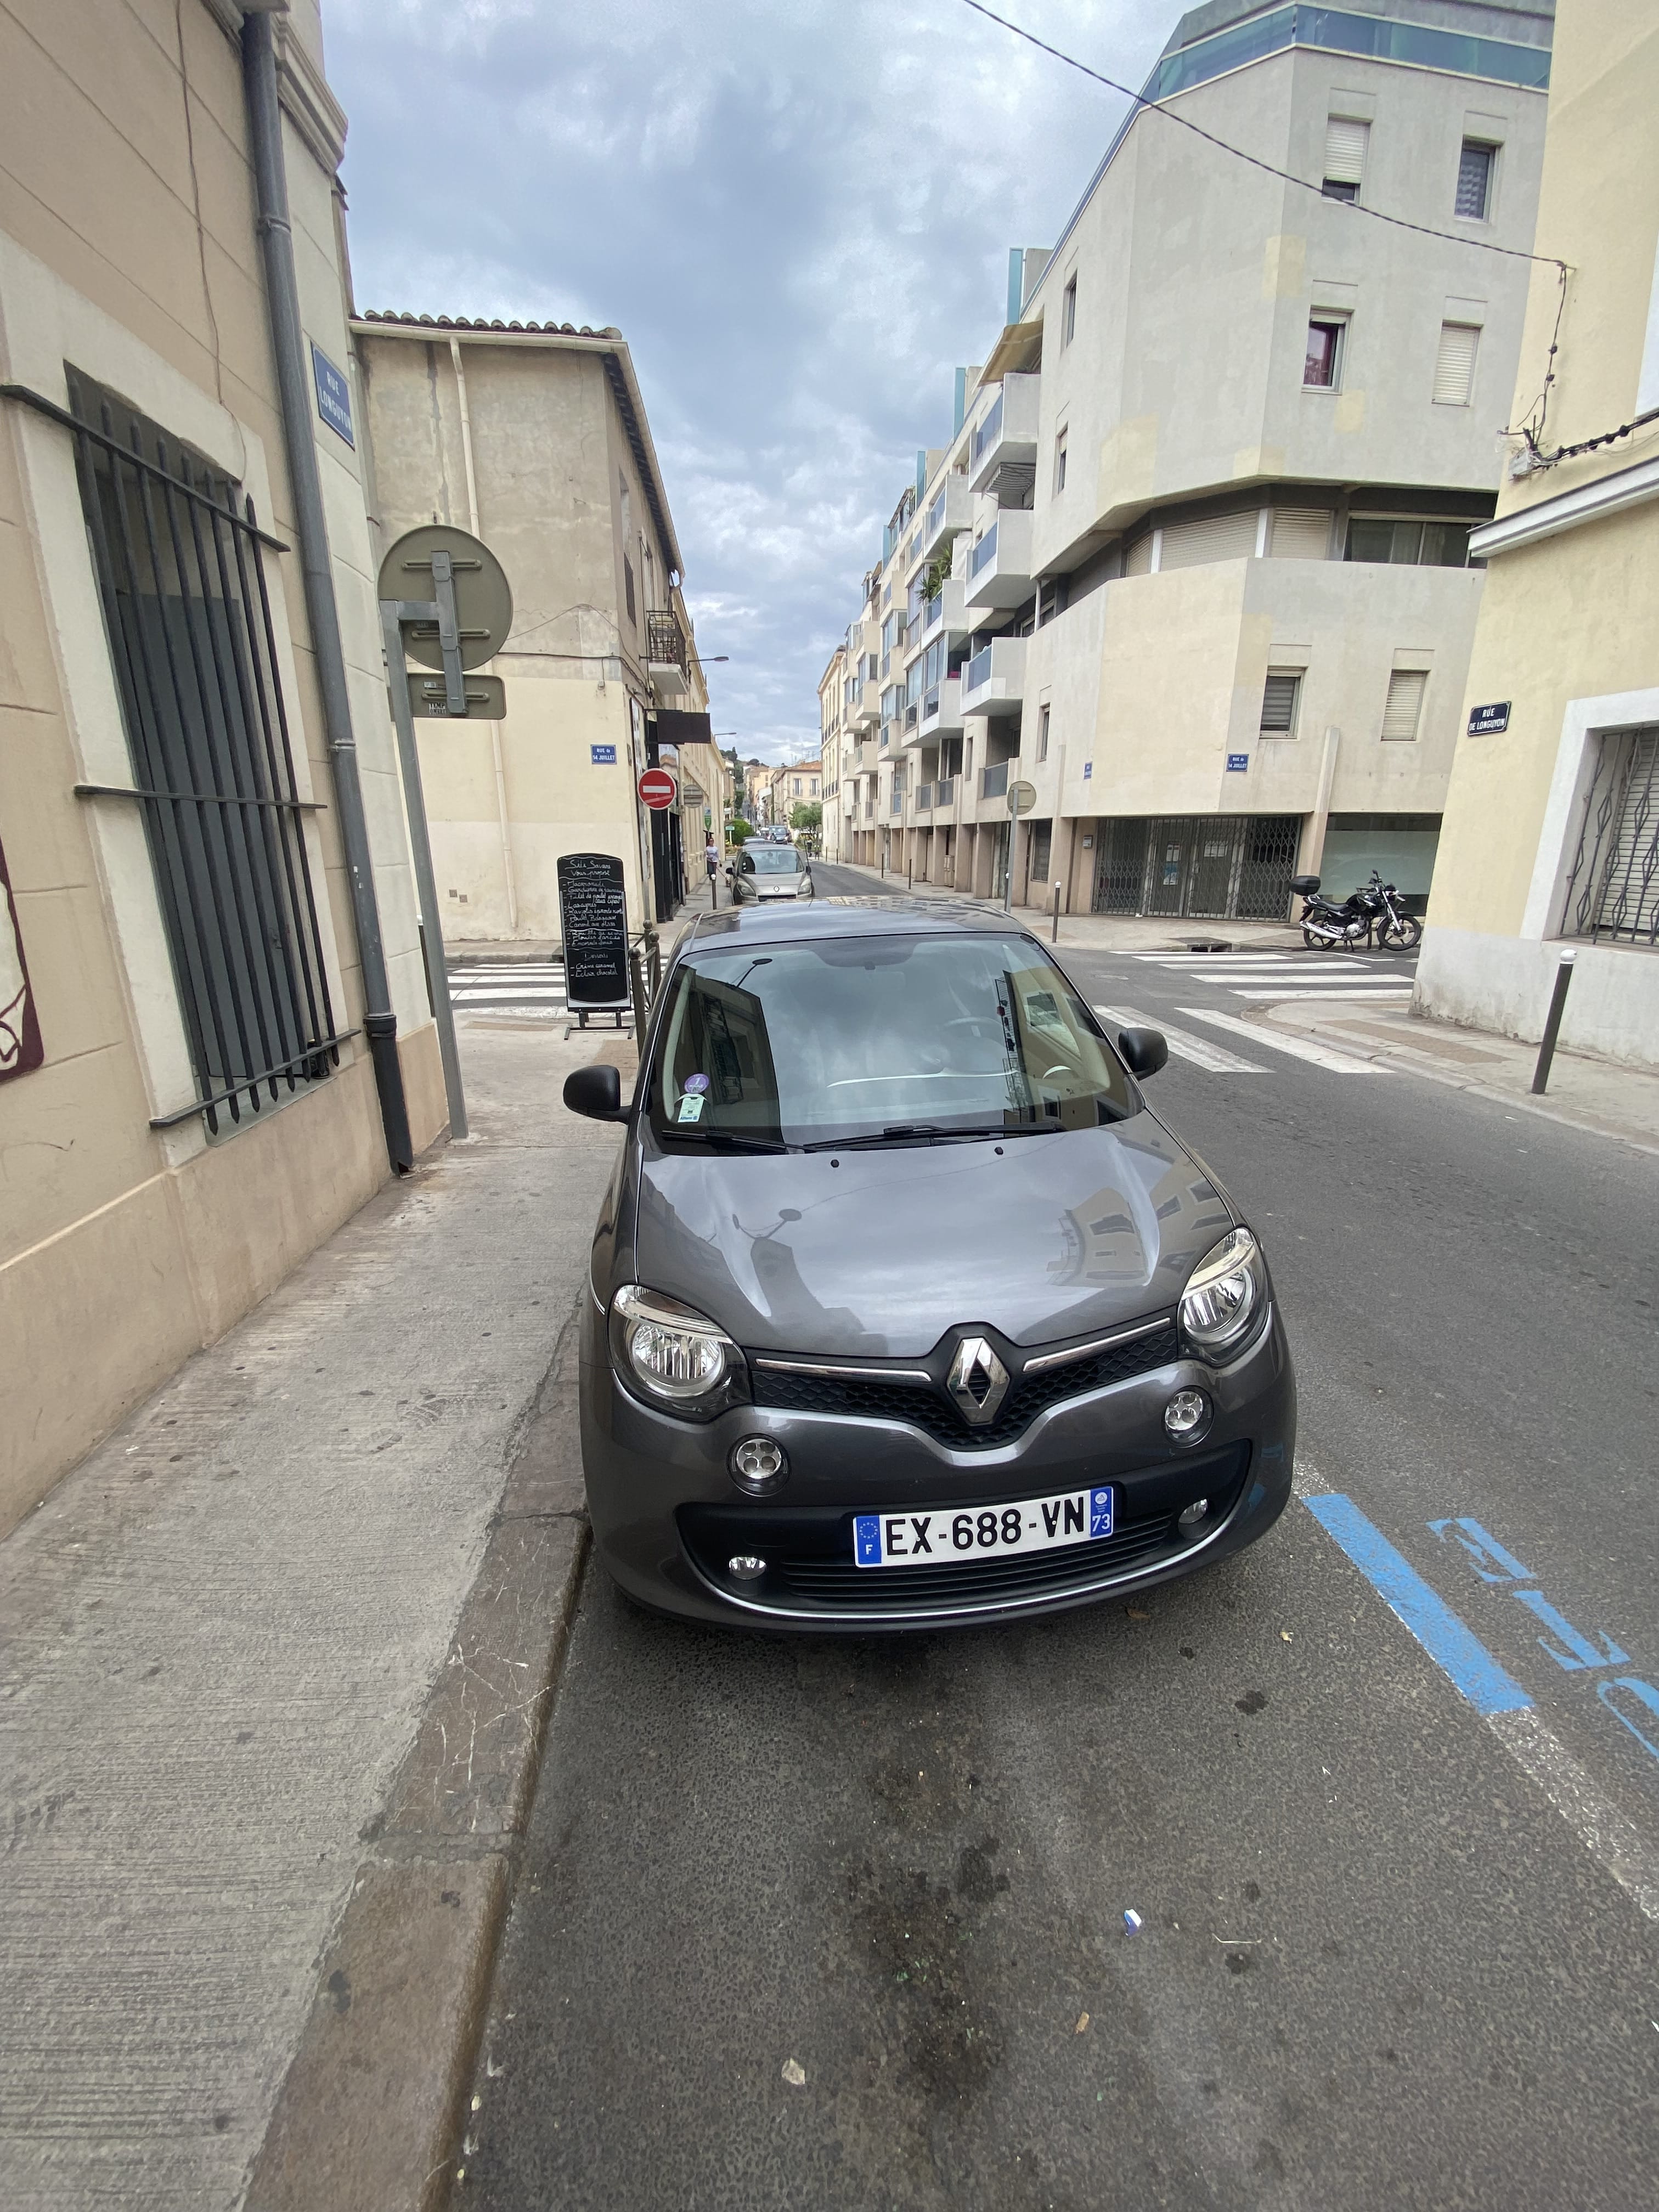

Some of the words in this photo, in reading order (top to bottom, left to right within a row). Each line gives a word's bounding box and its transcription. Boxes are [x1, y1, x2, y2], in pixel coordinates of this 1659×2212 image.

[326, 371, 340, 396] RUE
[1482, 708, 1495, 718] RUE
[1469, 723, 1476, 731] DE
[1476, 718, 1505, 730] LONGUYON
[885, 1496, 1085, 1556] EX-688-VN
[1092, 1513, 1110, 1532] 73
[865, 1544, 873, 1555] F
